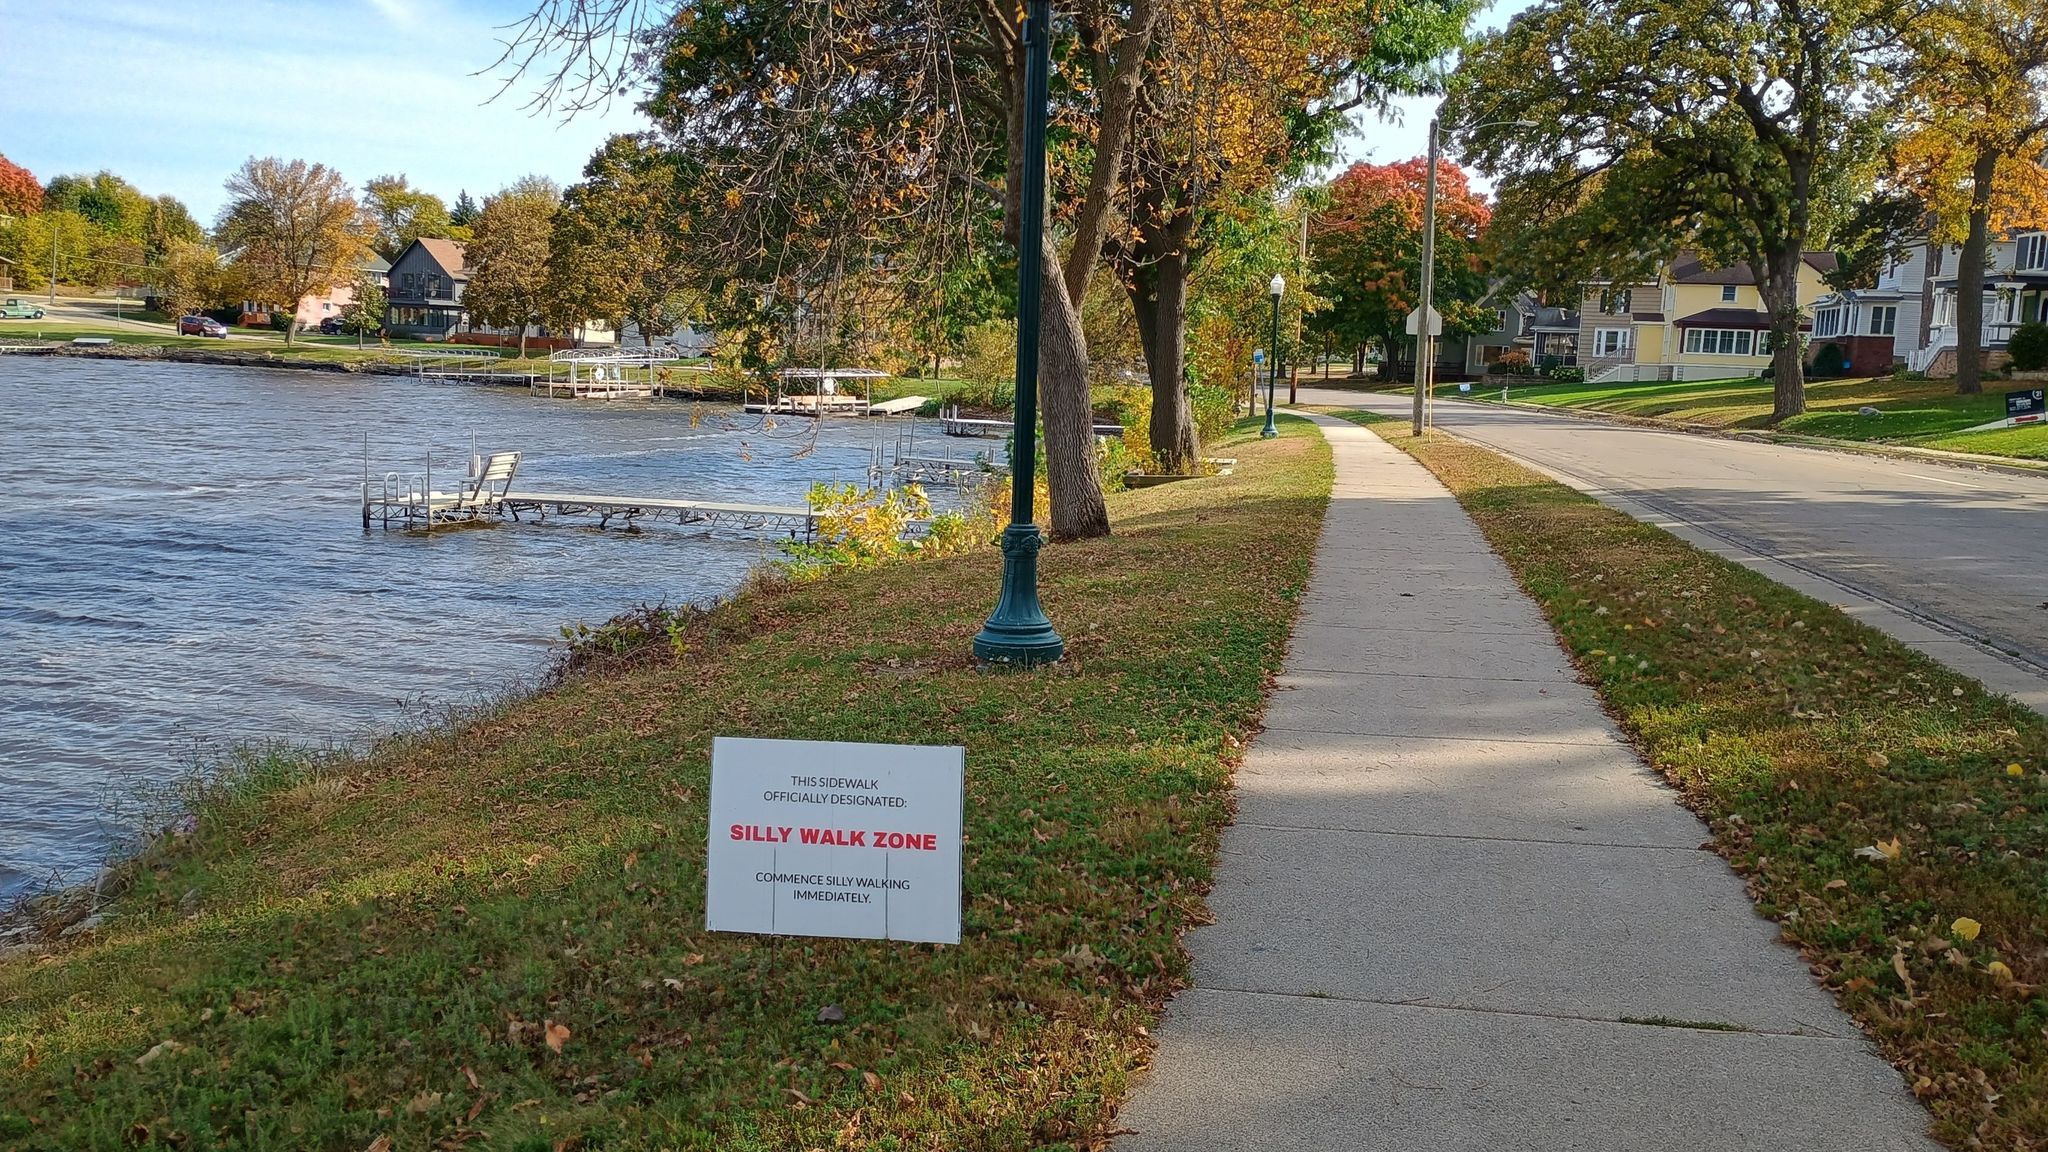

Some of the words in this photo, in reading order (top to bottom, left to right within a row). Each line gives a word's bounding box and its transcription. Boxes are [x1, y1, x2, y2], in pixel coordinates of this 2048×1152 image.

[791, 775, 817, 788] THIS
[819, 777, 879, 790] SIDEWALK
[763, 791, 829, 805] OFFICIALLY
[830, 794, 908, 808] DESIGNATED:
[730, 824, 793, 843] SILLY
[799, 828, 866, 847] WALK
[872, 832, 937, 851] ZONE
[755, 872, 824, 886] COMMENCE
[826, 875, 855, 888] SILLY
[856, 877, 911, 890] WALKING
[793, 889, 872, 904] IMMEDIATELY.
